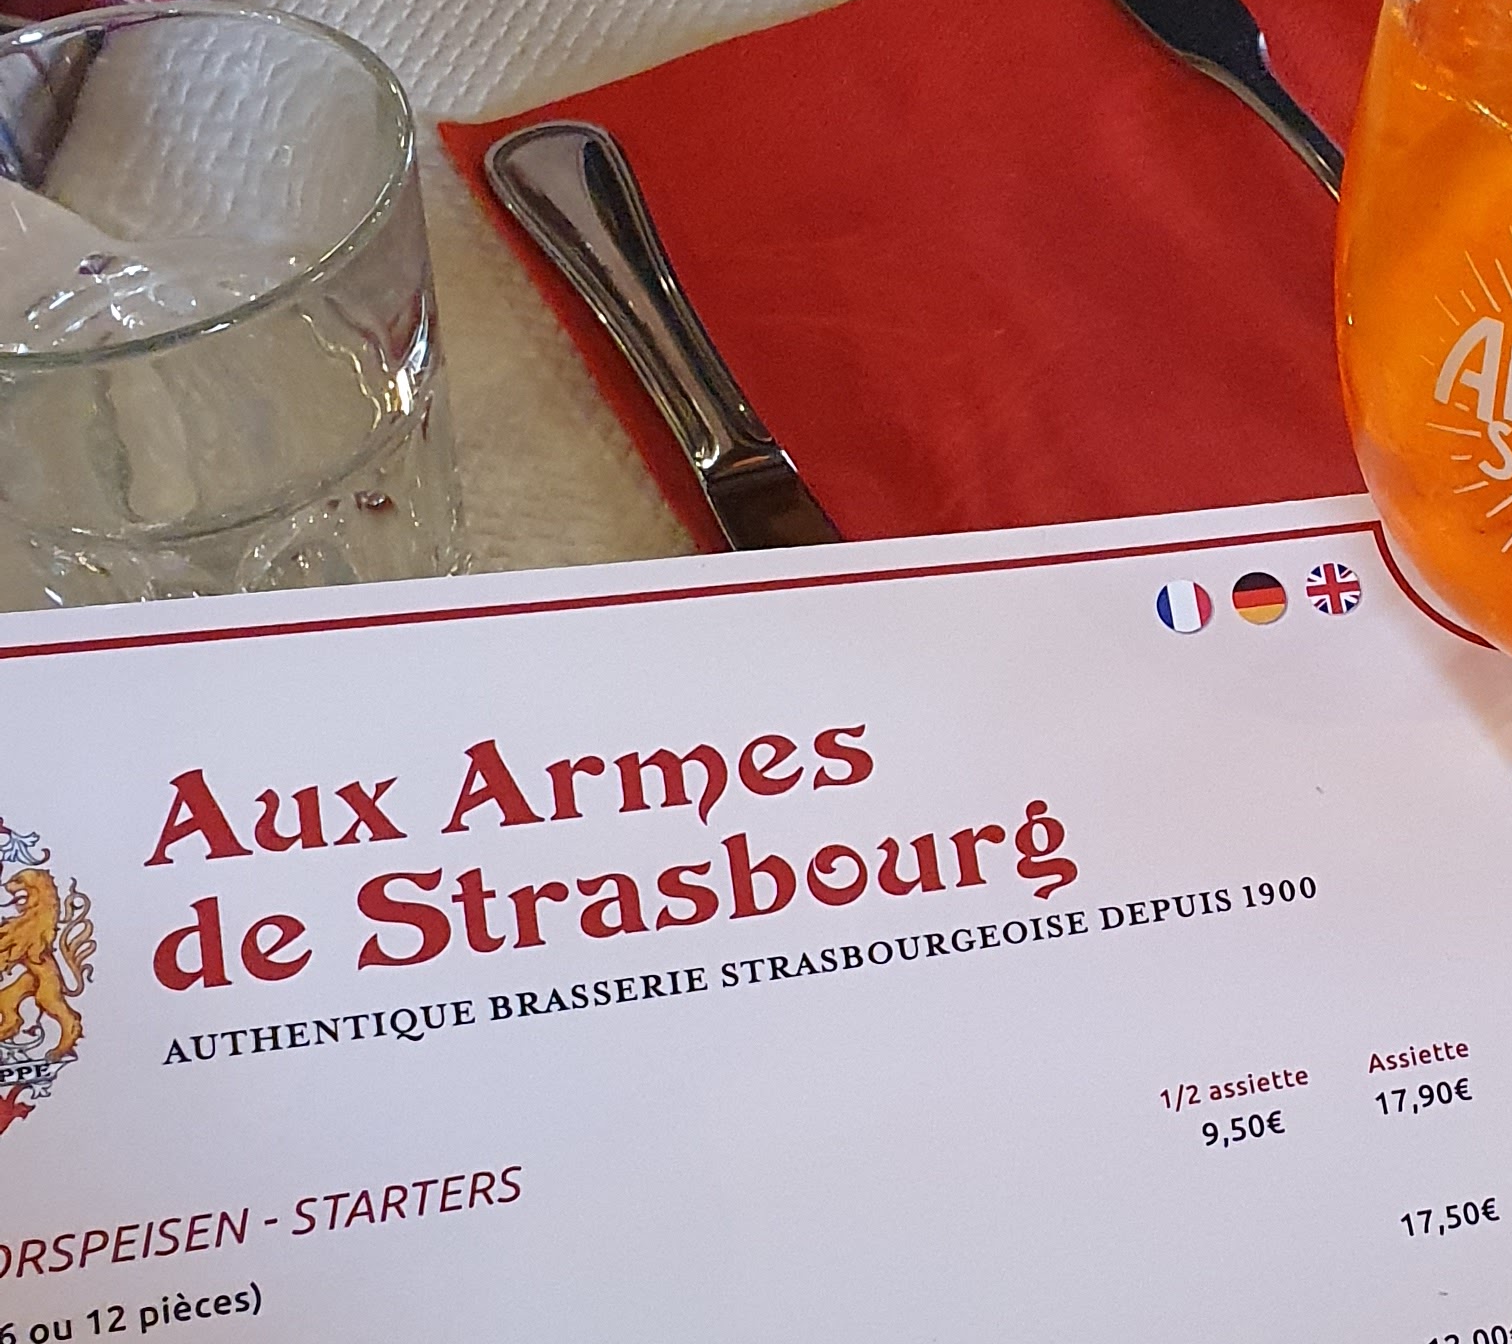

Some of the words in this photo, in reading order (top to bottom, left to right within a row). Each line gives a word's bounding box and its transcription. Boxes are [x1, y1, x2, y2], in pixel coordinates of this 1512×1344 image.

[143, 768, 409, 868] Aux
[440, 723, 874, 835] Armes
[152, 895, 313, 992] de
[356, 799, 1079, 971] Strasbourg
[161, 999, 476, 1066] AUTHENTIQUE
[487, 967, 709, 1022] BRASSERIE
[720, 910, 1089, 989] STRASBOURGEOISE
[1097, 888, 1232, 931] DEPUIS
[1241, 876, 1317, 909] 1900
[1368, 1041, 1470, 1074] Assiette
[1159, 1083, 1202, 1113] 1/2
[1208, 1069, 1309, 1101] assiette
[1374, 1077, 1473, 1116] 17,90€
[1201, 1109, 1286, 1149] 9,50€
[291, 1165, 523, 1236] STARTERS
[1400, 1197, 1501, 1237] 17,50€
[28, 1318, 73, 1344] ou
[85, 1304, 127, 1336] 12
[138, 1280, 262, 1335] pièces)
